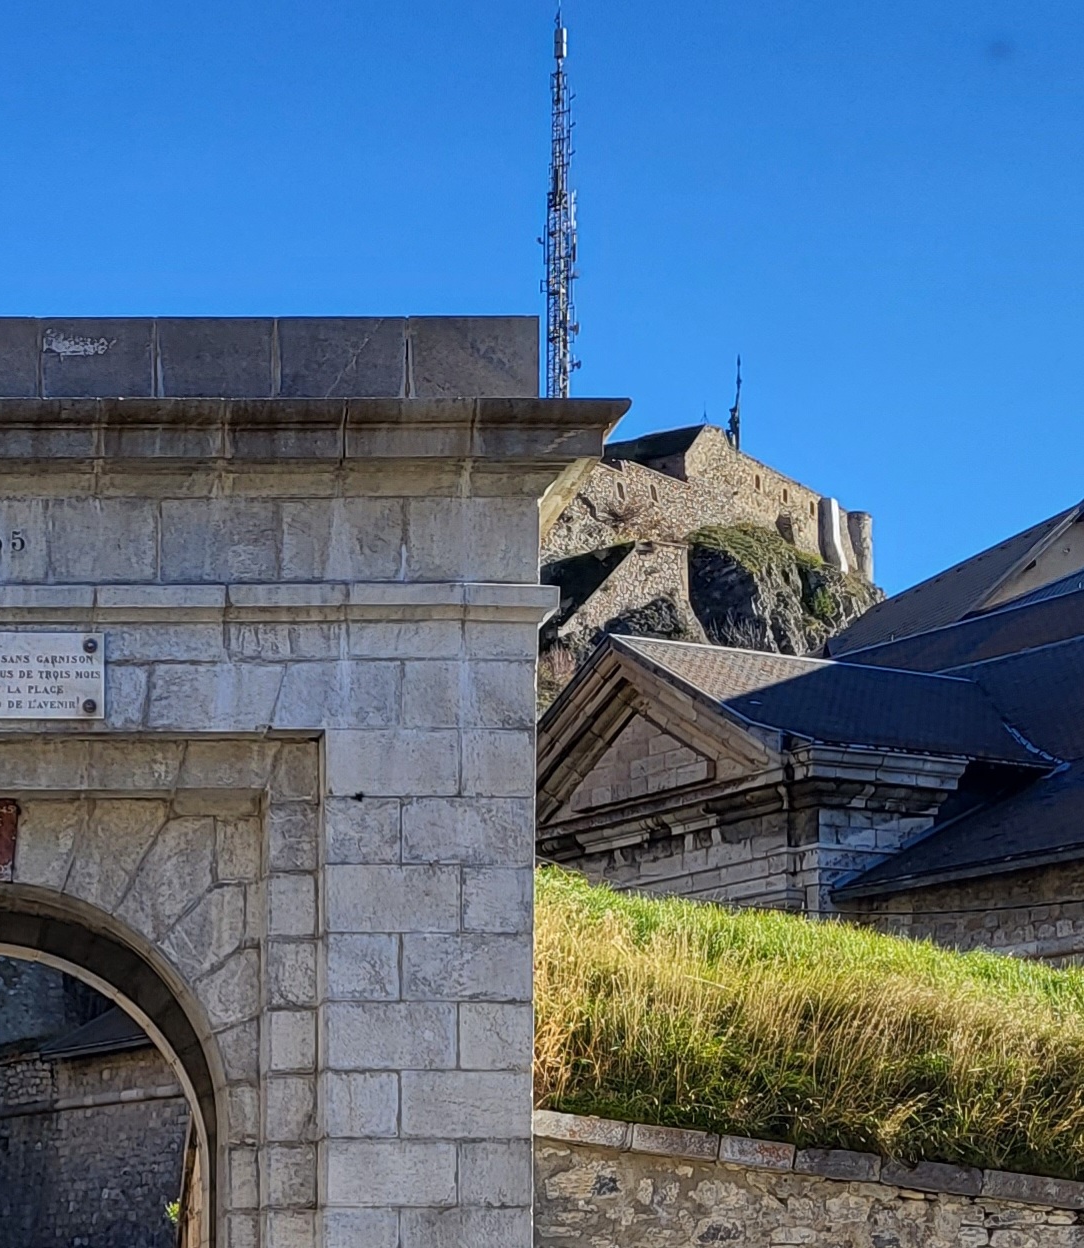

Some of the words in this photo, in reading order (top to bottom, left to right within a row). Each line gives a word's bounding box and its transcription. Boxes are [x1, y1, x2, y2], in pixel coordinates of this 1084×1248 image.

[0, 654, 30, 664] SANS
[36, 654, 94, 667] GARNISON
[19, 670, 34, 679] DE
[38, 670, 71, 681] TROIS
[75, 670, 101, 680] MOIS
[7, 685, 22, 694] LA
[27, 685, 64, 695] PLACE
[7, 699, 23, 709] DE
